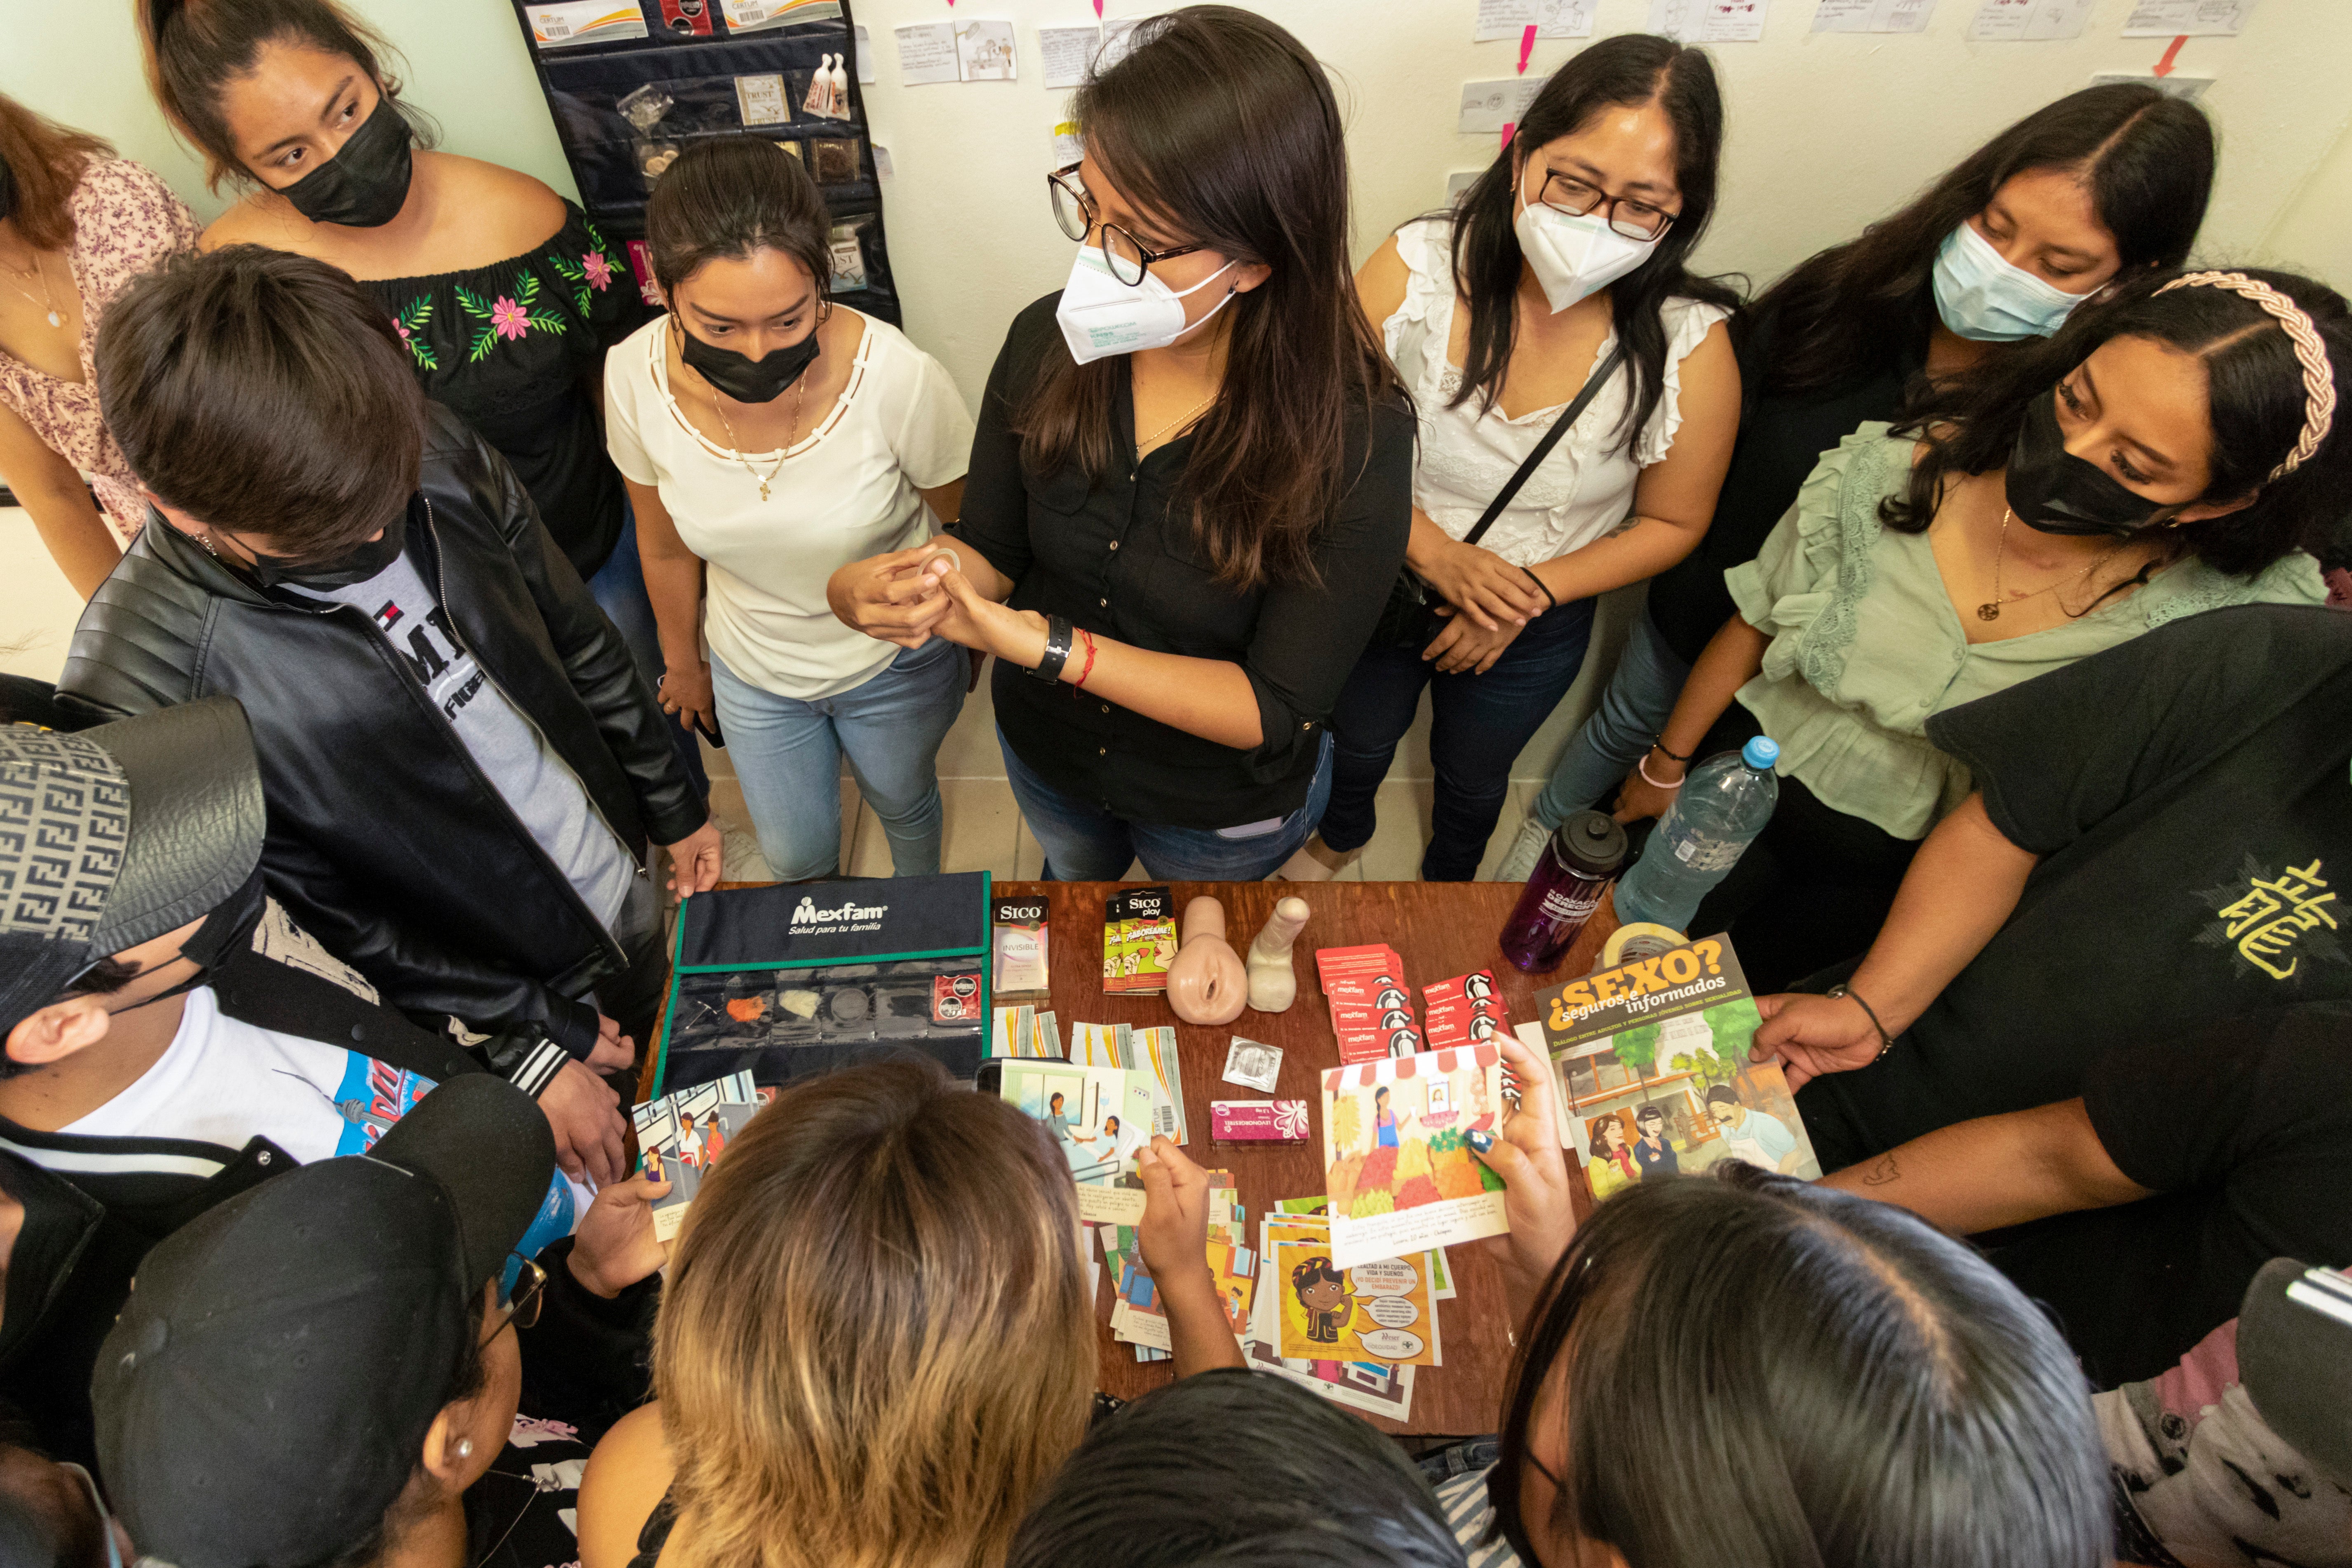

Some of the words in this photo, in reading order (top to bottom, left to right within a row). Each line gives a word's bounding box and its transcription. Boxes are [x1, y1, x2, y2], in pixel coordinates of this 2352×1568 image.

[1547, 893, 1599, 910] DERECHO
[1556, 893, 1596, 905] OAXACA
[791, 902, 883, 924] Mexfam
[789, 926, 816, 934] Salud
[815, 927, 836, 935] para
[850, 922, 881, 931] familia
[1425, 983, 1450, 994] mexfam
[1548, 940, 1722, 1031] ¿SEXO?
[1626, 976, 1726, 1013] informados
[1429, 1006, 1454, 1015] mexfam
[1562, 994, 1625, 1022] seguros
[1630, 990, 1639, 1000] e
[1579, 1030, 1596, 1039] ENTRE
[1598, 1023, 1622, 1033] ADULTOS
[1628, 1013, 1657, 1024] PERSONAS
[1705, 989, 1742, 1002] SEXUALIDAD
[1428, 1024, 1454, 1034] mexfam
